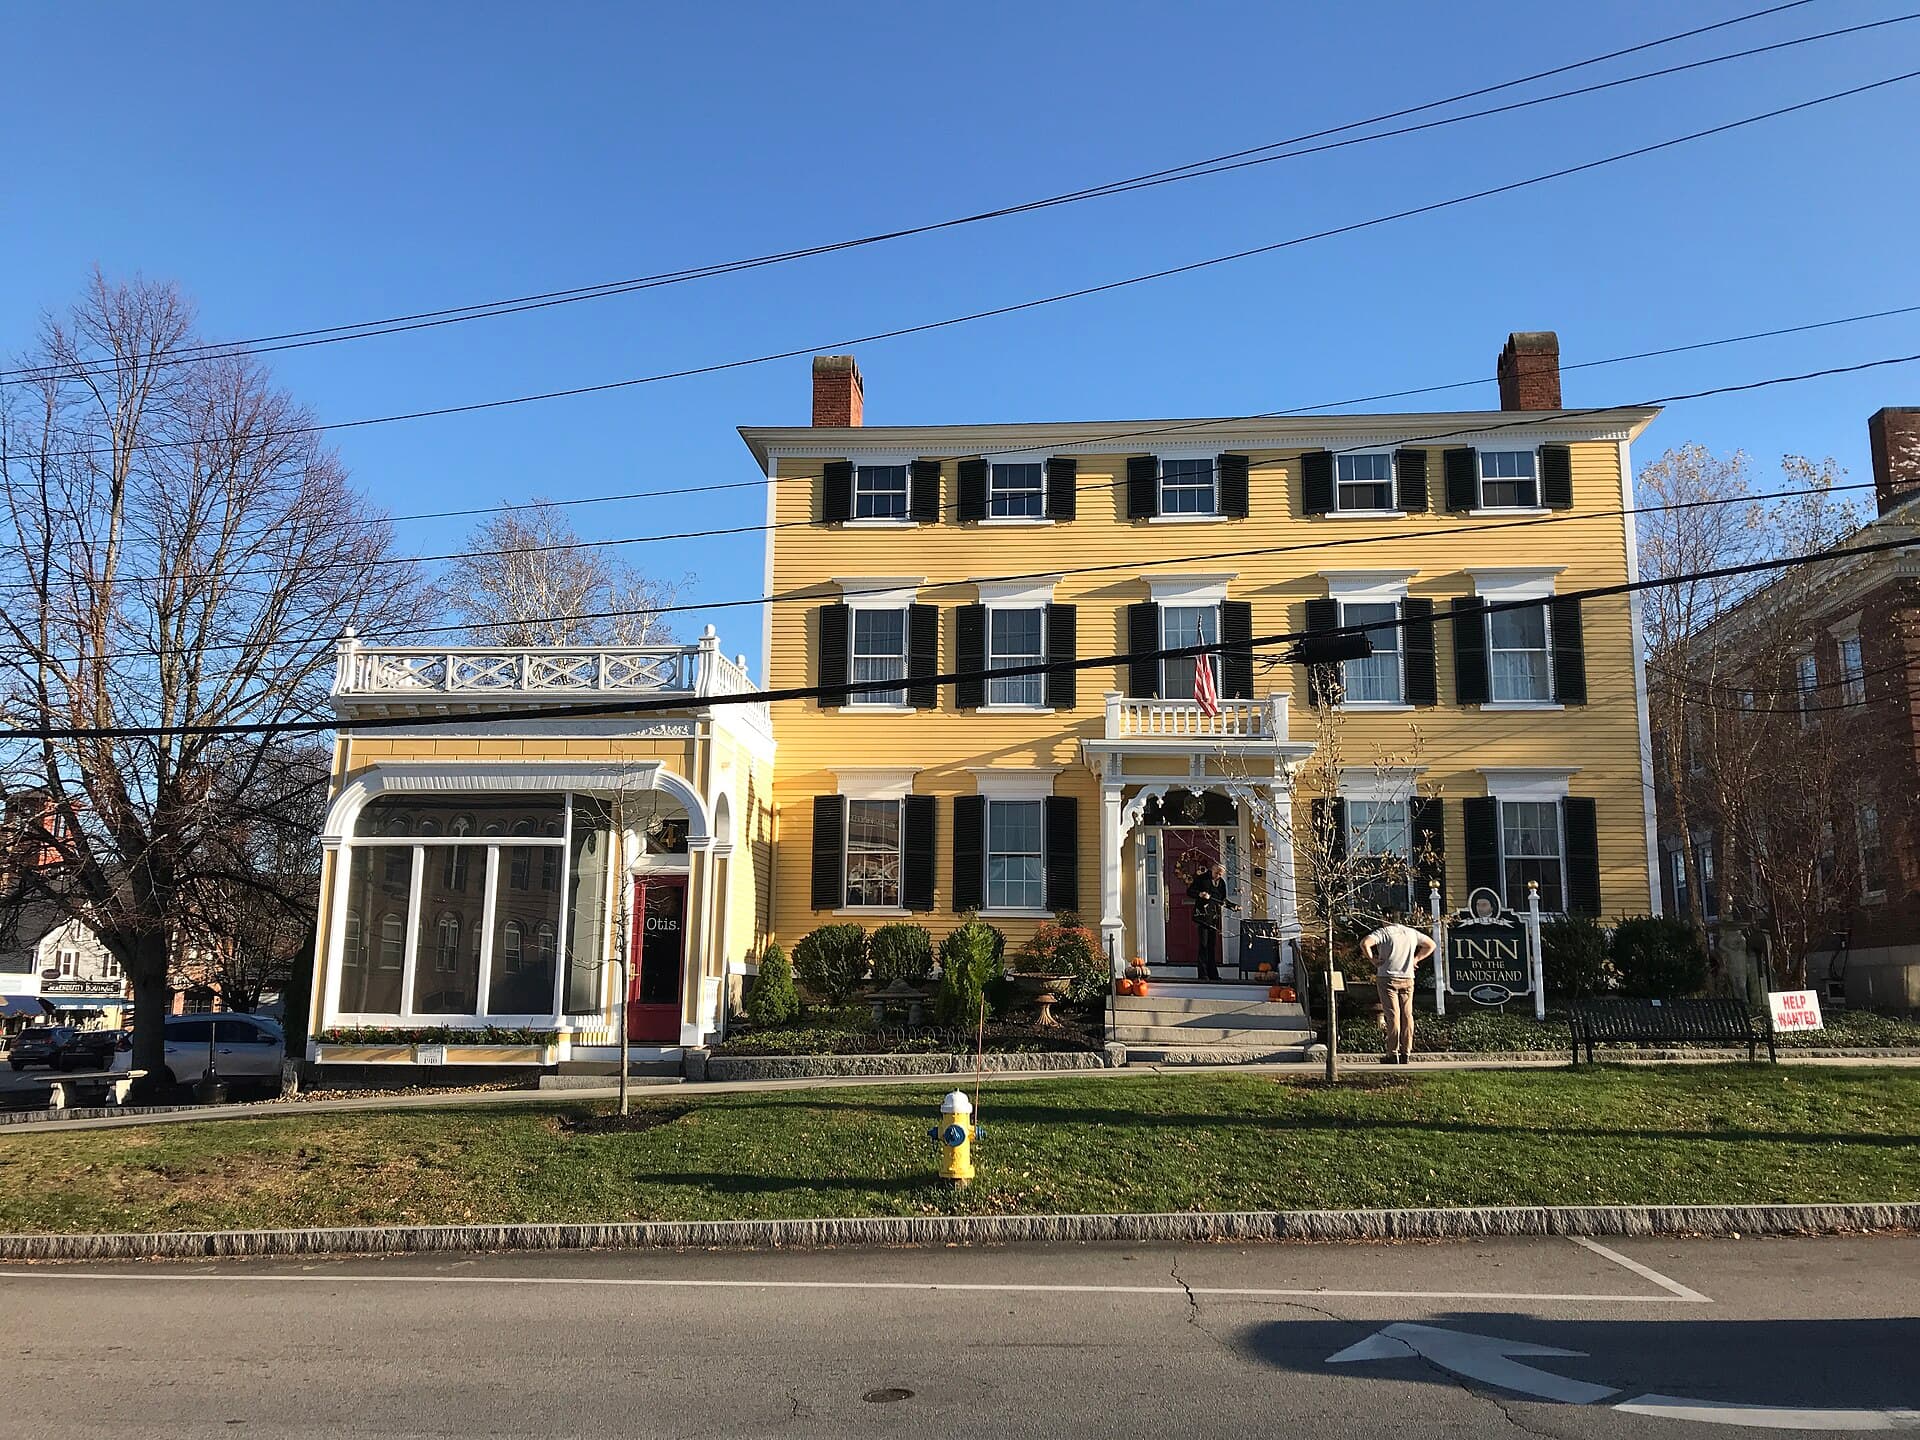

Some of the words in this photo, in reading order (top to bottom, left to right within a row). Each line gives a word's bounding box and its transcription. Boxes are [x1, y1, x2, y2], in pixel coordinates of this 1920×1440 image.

[660, 826, 677, 848] 4
[646, 917, 681, 931] Otis.
[1454, 938, 1520, 960] INN
[1471, 961, 1483, 969] BY
[1486, 961, 1505, 969] THE
[1455, 970, 1522, 982] BANDSTAND
[1782, 995, 1806, 1010] HELP
[1777, 1010, 1817, 1027] WANTED
